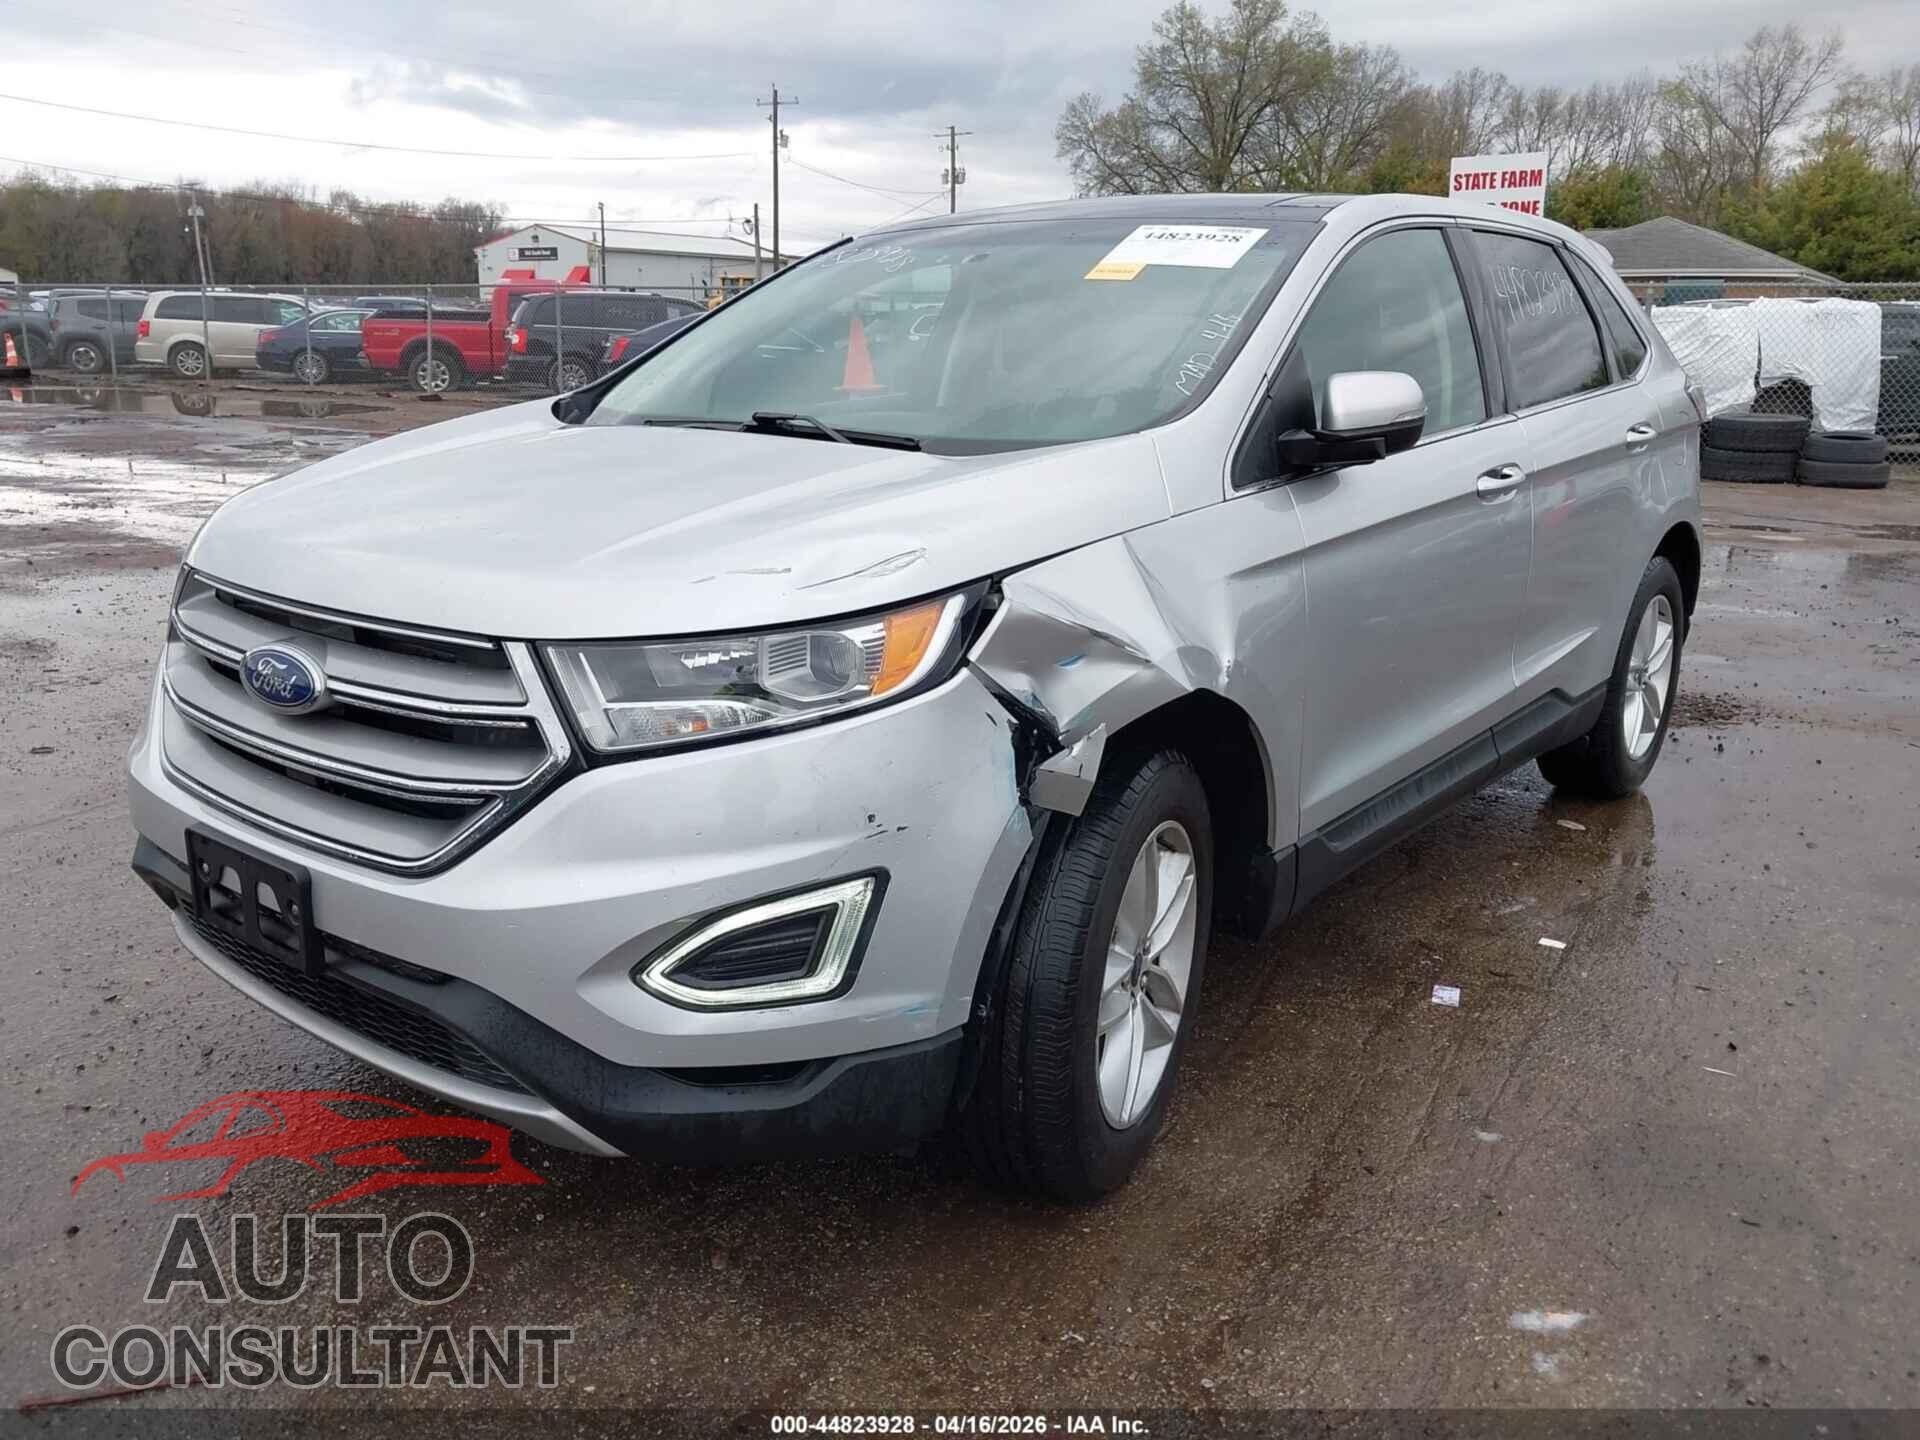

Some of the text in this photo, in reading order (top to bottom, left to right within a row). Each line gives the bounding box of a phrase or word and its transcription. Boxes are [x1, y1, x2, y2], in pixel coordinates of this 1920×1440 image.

[1454, 169, 1543, 191] STATE FARM
[1500, 201, 1541, 216] ONE
[252, 657, 297, 698] Ford
